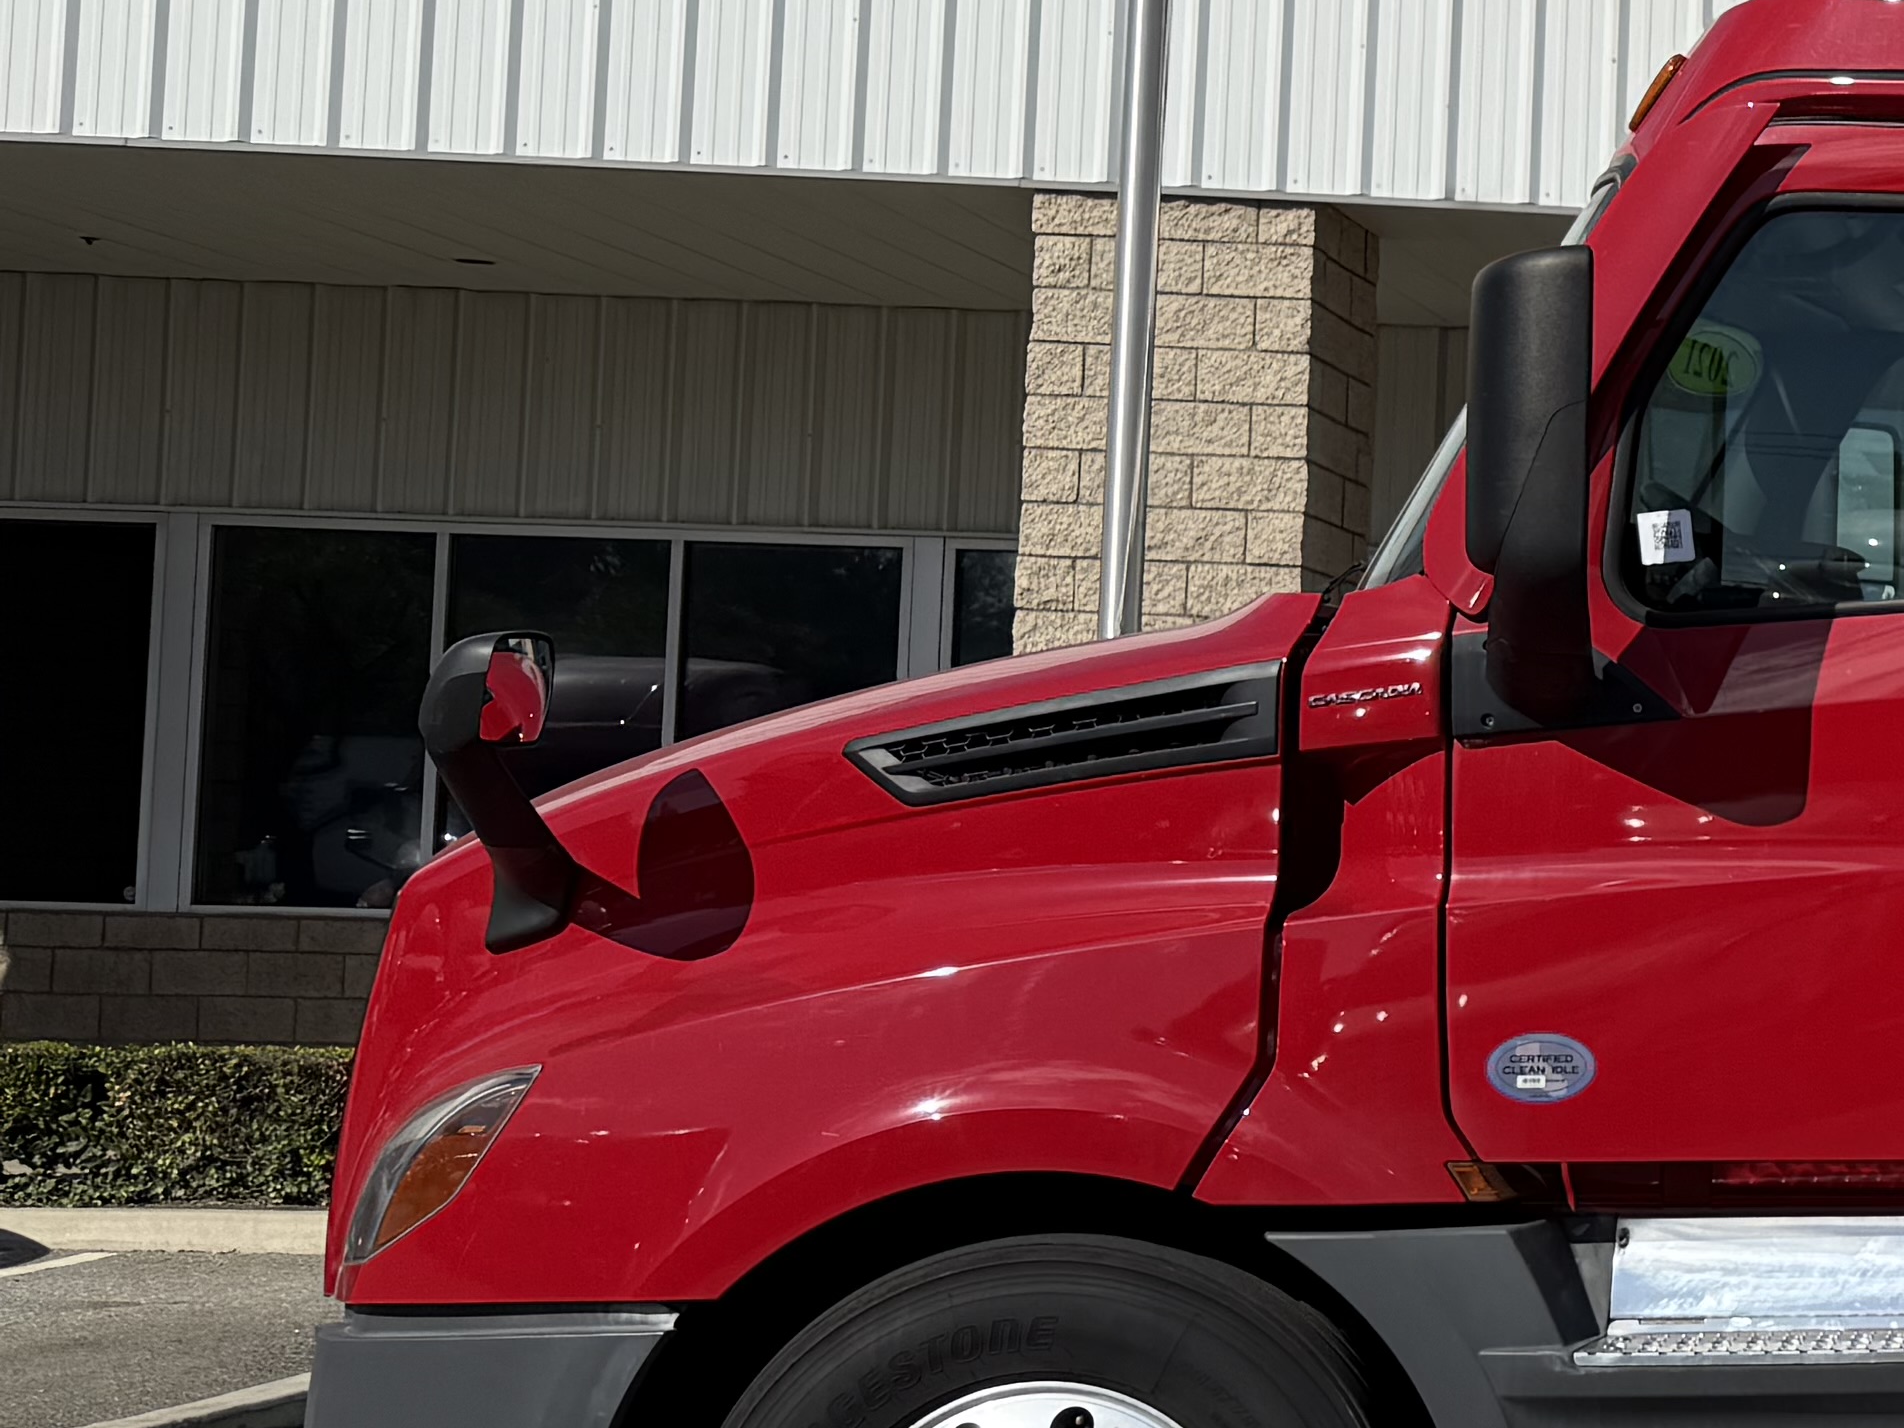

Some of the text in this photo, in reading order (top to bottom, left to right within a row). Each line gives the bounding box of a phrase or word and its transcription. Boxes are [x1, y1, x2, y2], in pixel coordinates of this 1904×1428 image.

[1509, 1054, 1573, 1063] CERTIFIED
[1503, 1065, 1580, 1075] CLEAN IDLE
